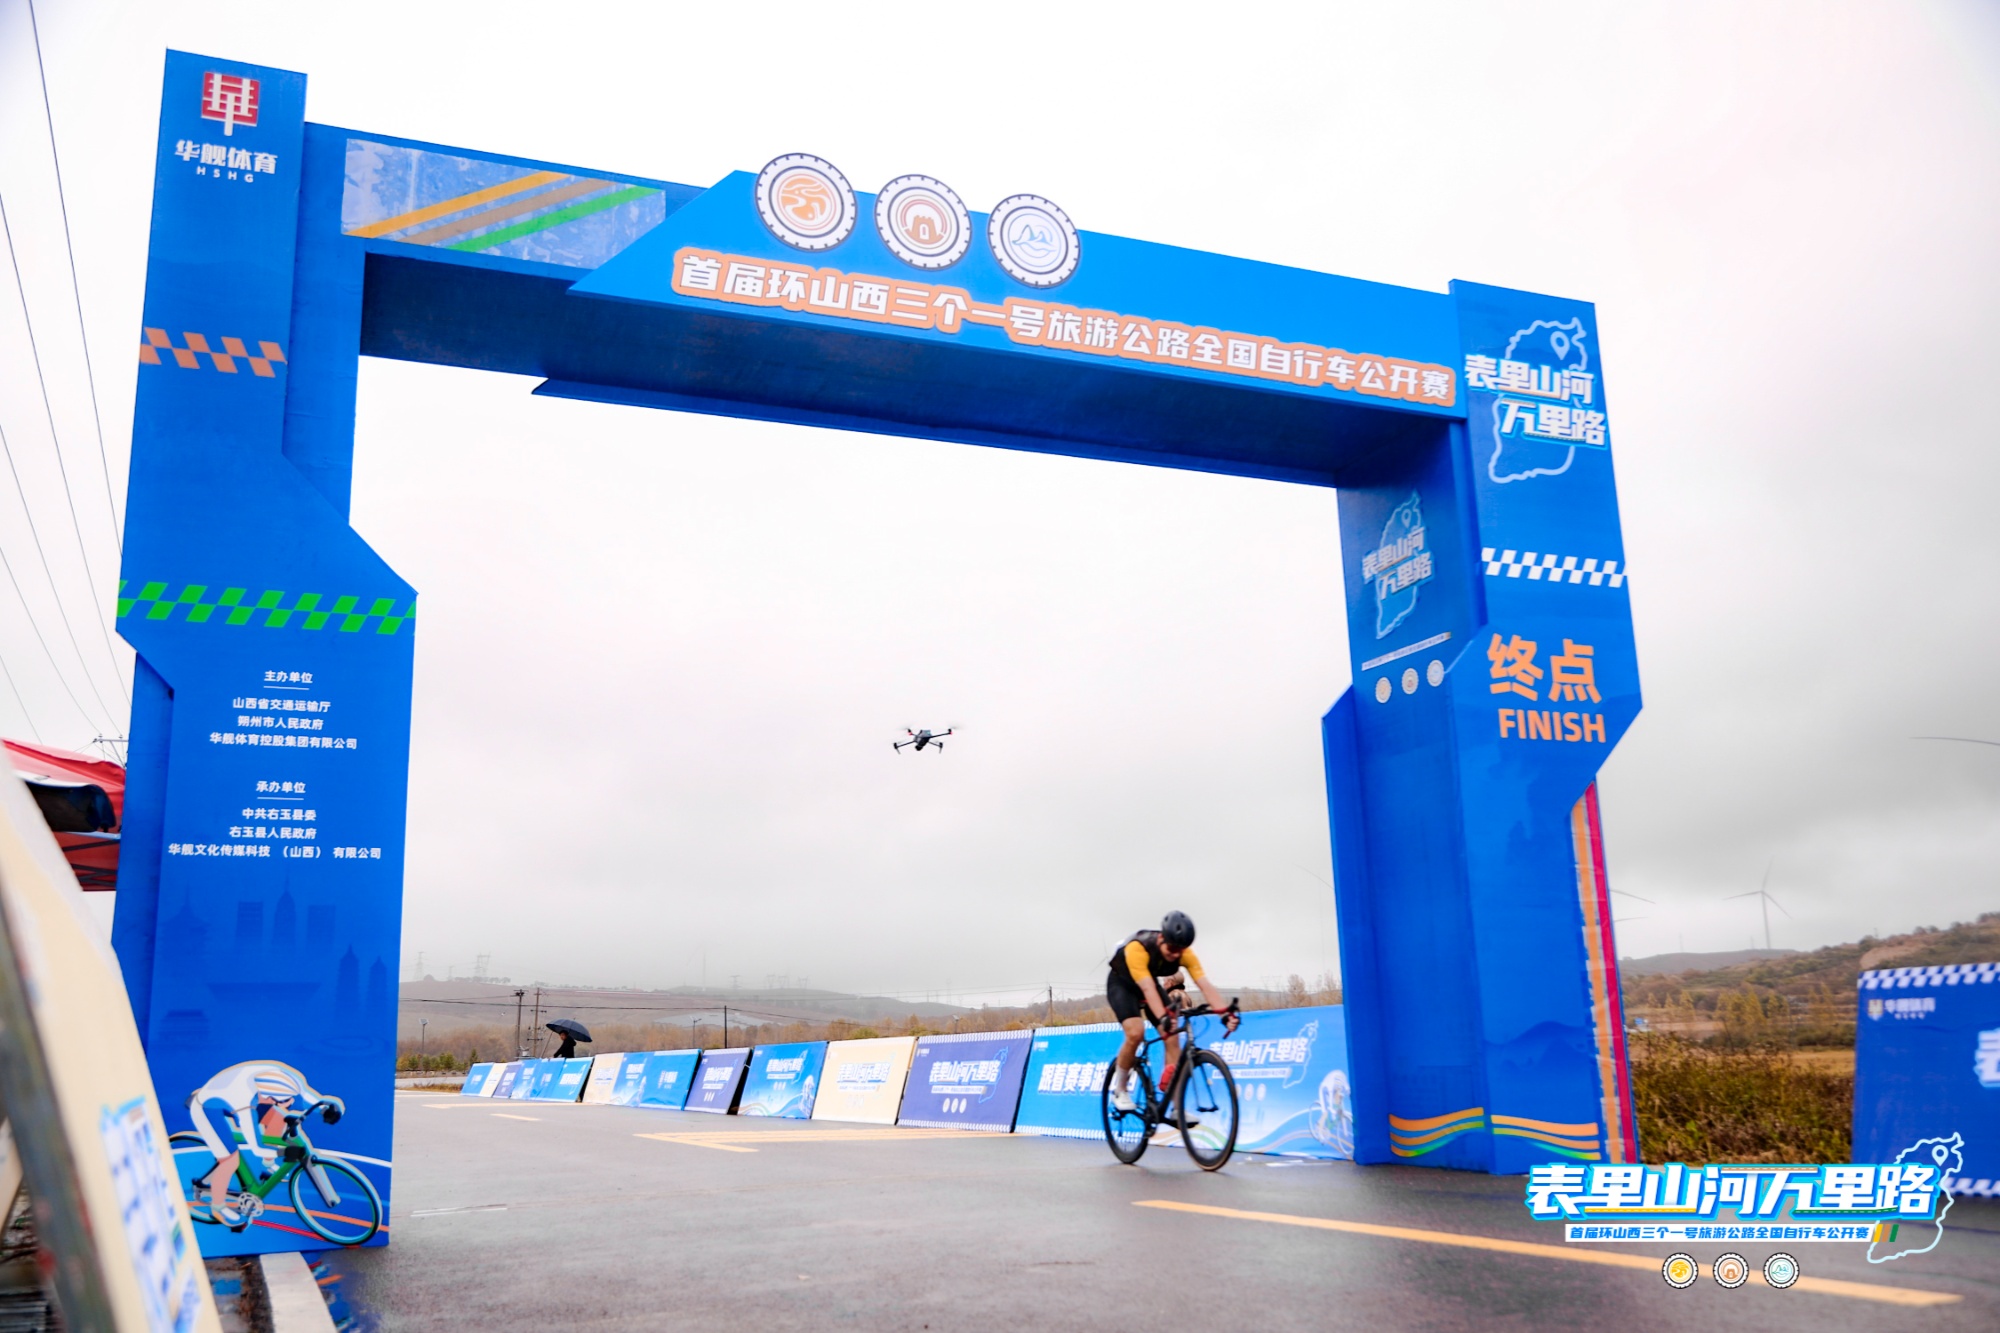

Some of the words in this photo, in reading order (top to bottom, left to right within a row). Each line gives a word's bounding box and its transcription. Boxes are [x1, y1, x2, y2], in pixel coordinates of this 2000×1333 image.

[175, 139, 278, 174] 华舰体育
[196, 166, 254, 183] HSHG
[680, 255, 1450, 400] 首届环山西三个一号旅游公路全国自行车公开赛
[1465, 354, 1594, 404] 表里山河
[1500, 398, 1606, 446] 万里路
[1362, 526, 1424, 581] 表里山河
[1380, 551, 1432, 600] 万里路
[264, 670, 313, 684] 主办单位
[1487, 633, 1602, 703] 终点
[233, 697, 331, 713] 山西省交通运输厅
[237, 715, 324, 730] 朔州市人民政府
[1498, 708, 1606, 743] FINISH
[256, 780, 306, 794] 承办单位
[242, 807, 317, 821] 中共右玉县委
[229, 826, 317, 840] 右玉县人民政府
